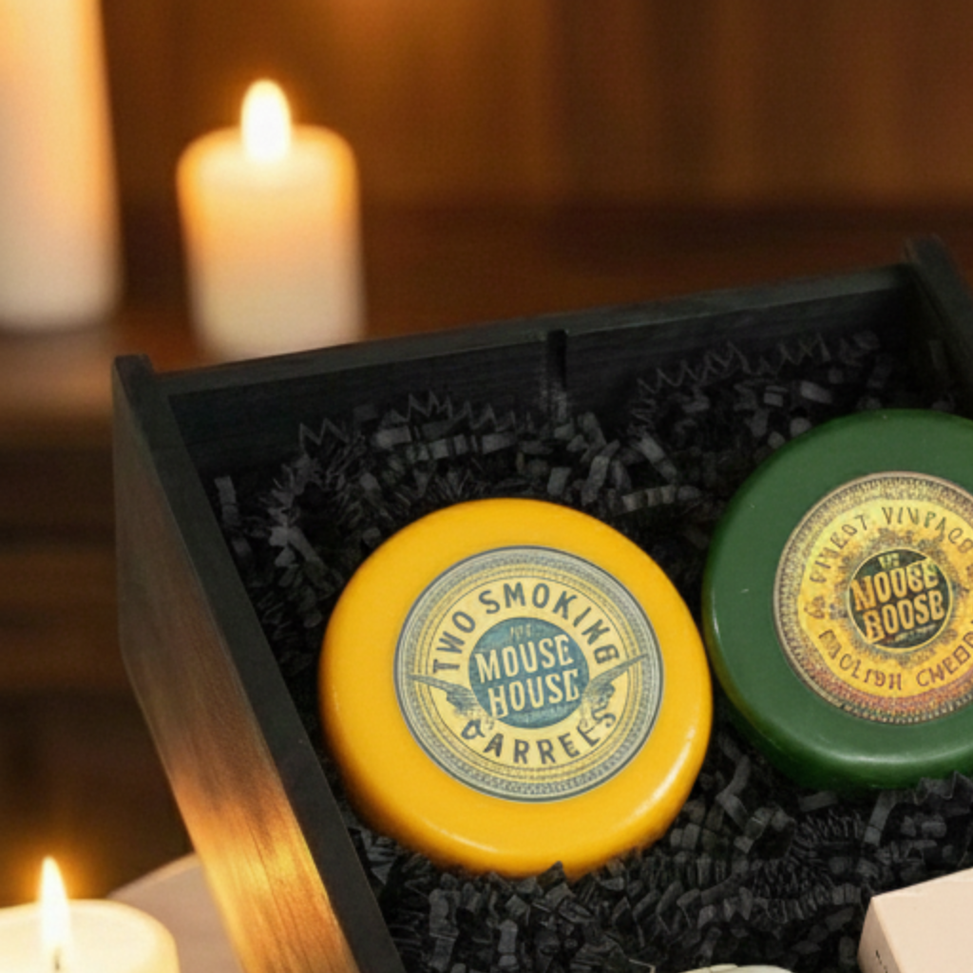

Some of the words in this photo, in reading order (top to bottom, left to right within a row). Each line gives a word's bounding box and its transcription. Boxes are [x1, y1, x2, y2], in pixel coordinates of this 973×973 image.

[433, 611, 476, 673] TWO
[474, 634, 574, 683] MOUSE
[488, 669, 580, 718] HOUSE
